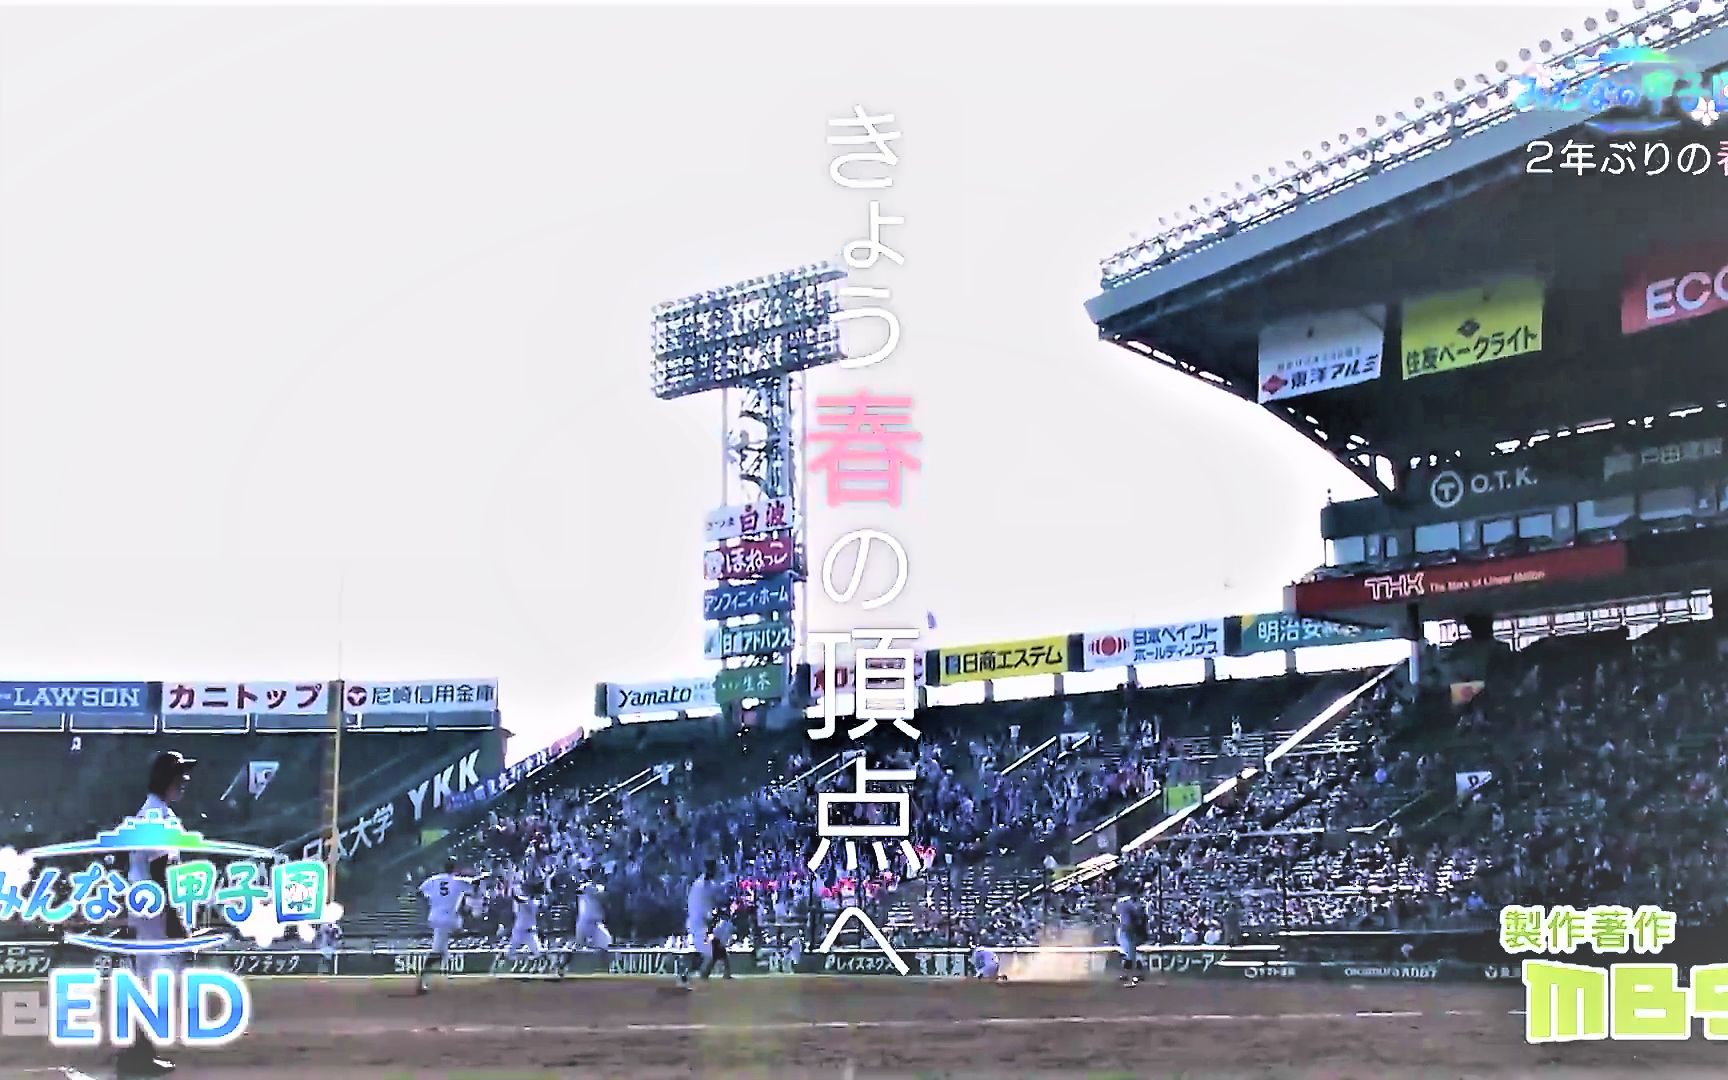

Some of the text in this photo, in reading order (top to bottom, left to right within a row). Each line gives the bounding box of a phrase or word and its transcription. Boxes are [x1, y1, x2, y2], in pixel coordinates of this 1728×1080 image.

[1470, 466, 1538, 494] O.T.K.
[1364, 572, 1425, 601] THK
[1132, 623, 1218, 648] 日本ペイント
[963, 646, 1063, 673] 日商エステム
[14, 686, 141, 708] LAWSON
[168, 683, 322, 710] カニトップ
[372, 684, 496, 705] 尼崎信用金庫
[618, 686, 692, 708] Yamato
[407, 749, 480, 821] YKK
[439, 880, 450, 896] 5
